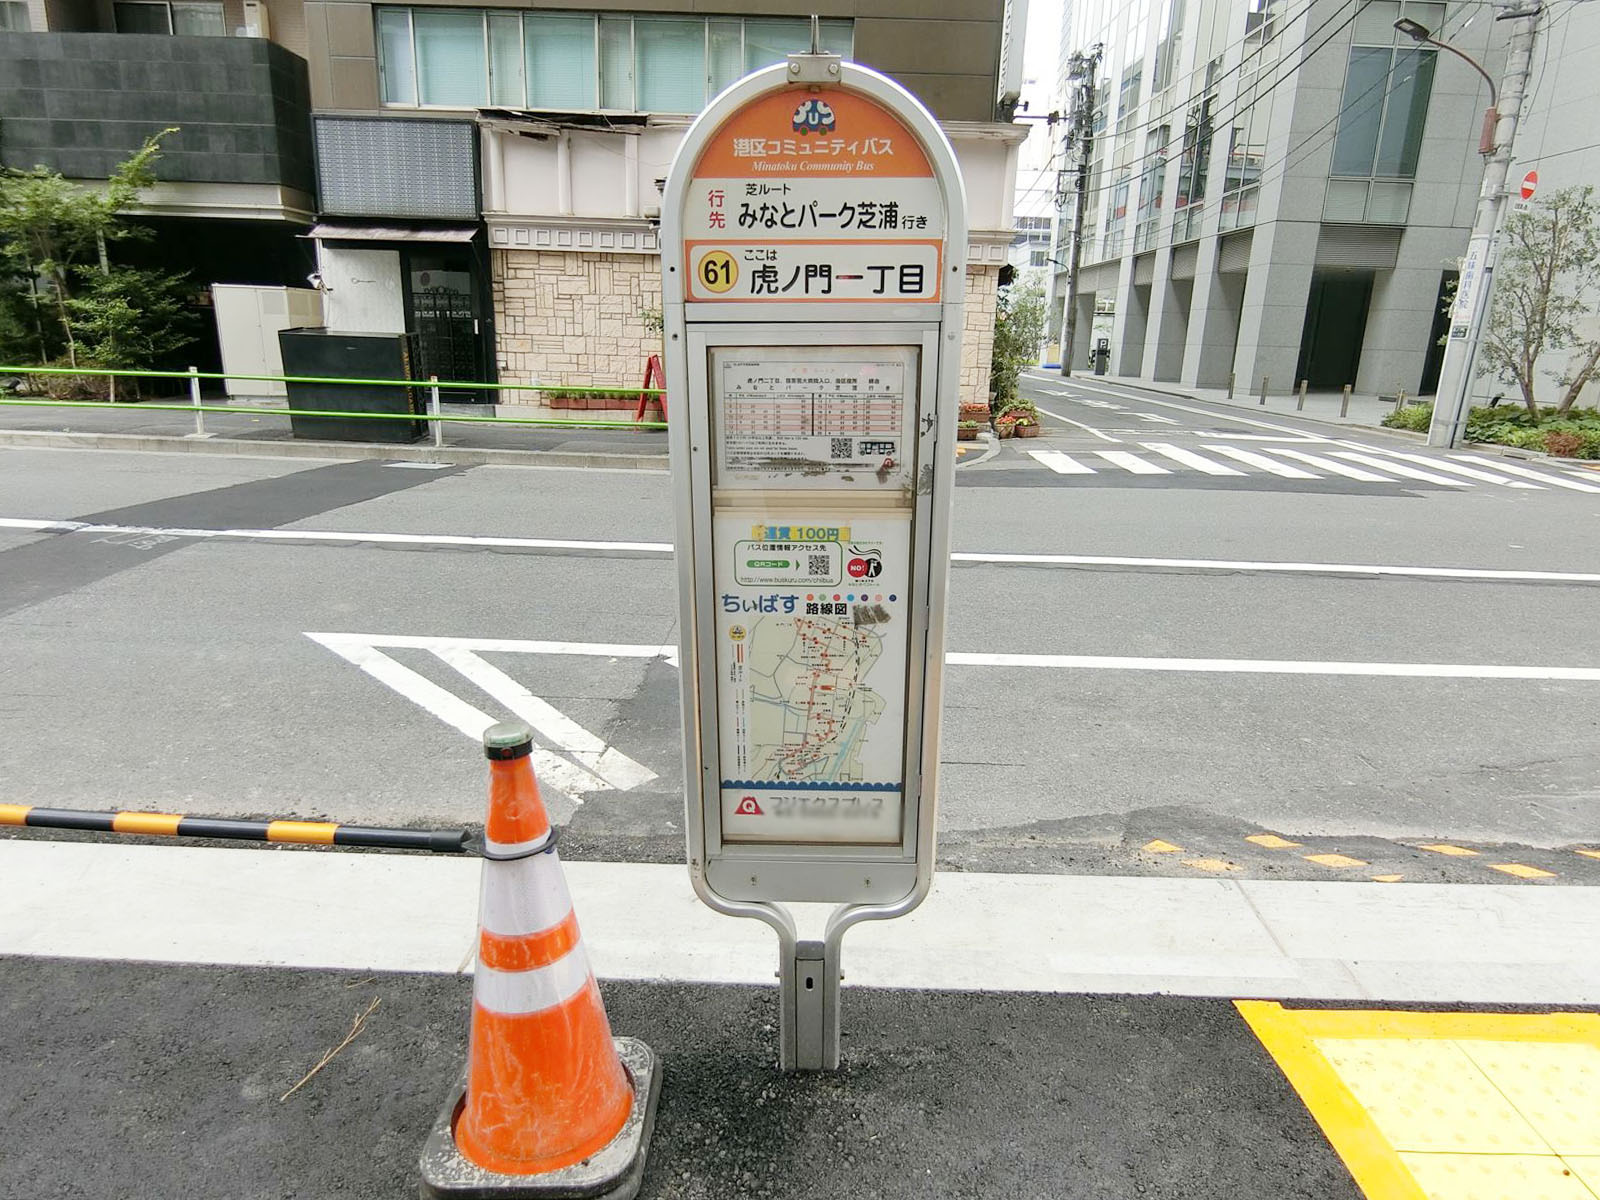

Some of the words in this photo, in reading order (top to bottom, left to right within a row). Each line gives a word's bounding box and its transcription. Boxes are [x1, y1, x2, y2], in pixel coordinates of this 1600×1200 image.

[733, 138, 894, 157] 港区コミュニティバス
[752, 160, 797, 171] Minatoku
[799, 161, 855, 174] Community
[856, 160, 875, 171] Bus
[745, 183, 791, 196] 芝ルート
[708, 190, 726, 229] 行先
[744, 250, 777, 261] ここは
[703, 259, 732, 285] 61
[750, 264, 923, 295] 虎ノ門一丁目
[797, 527, 839, 541] 100円
[747, 544, 827, 552] バス位置情報アクセス先
[806, 603, 847, 615] 路線図
